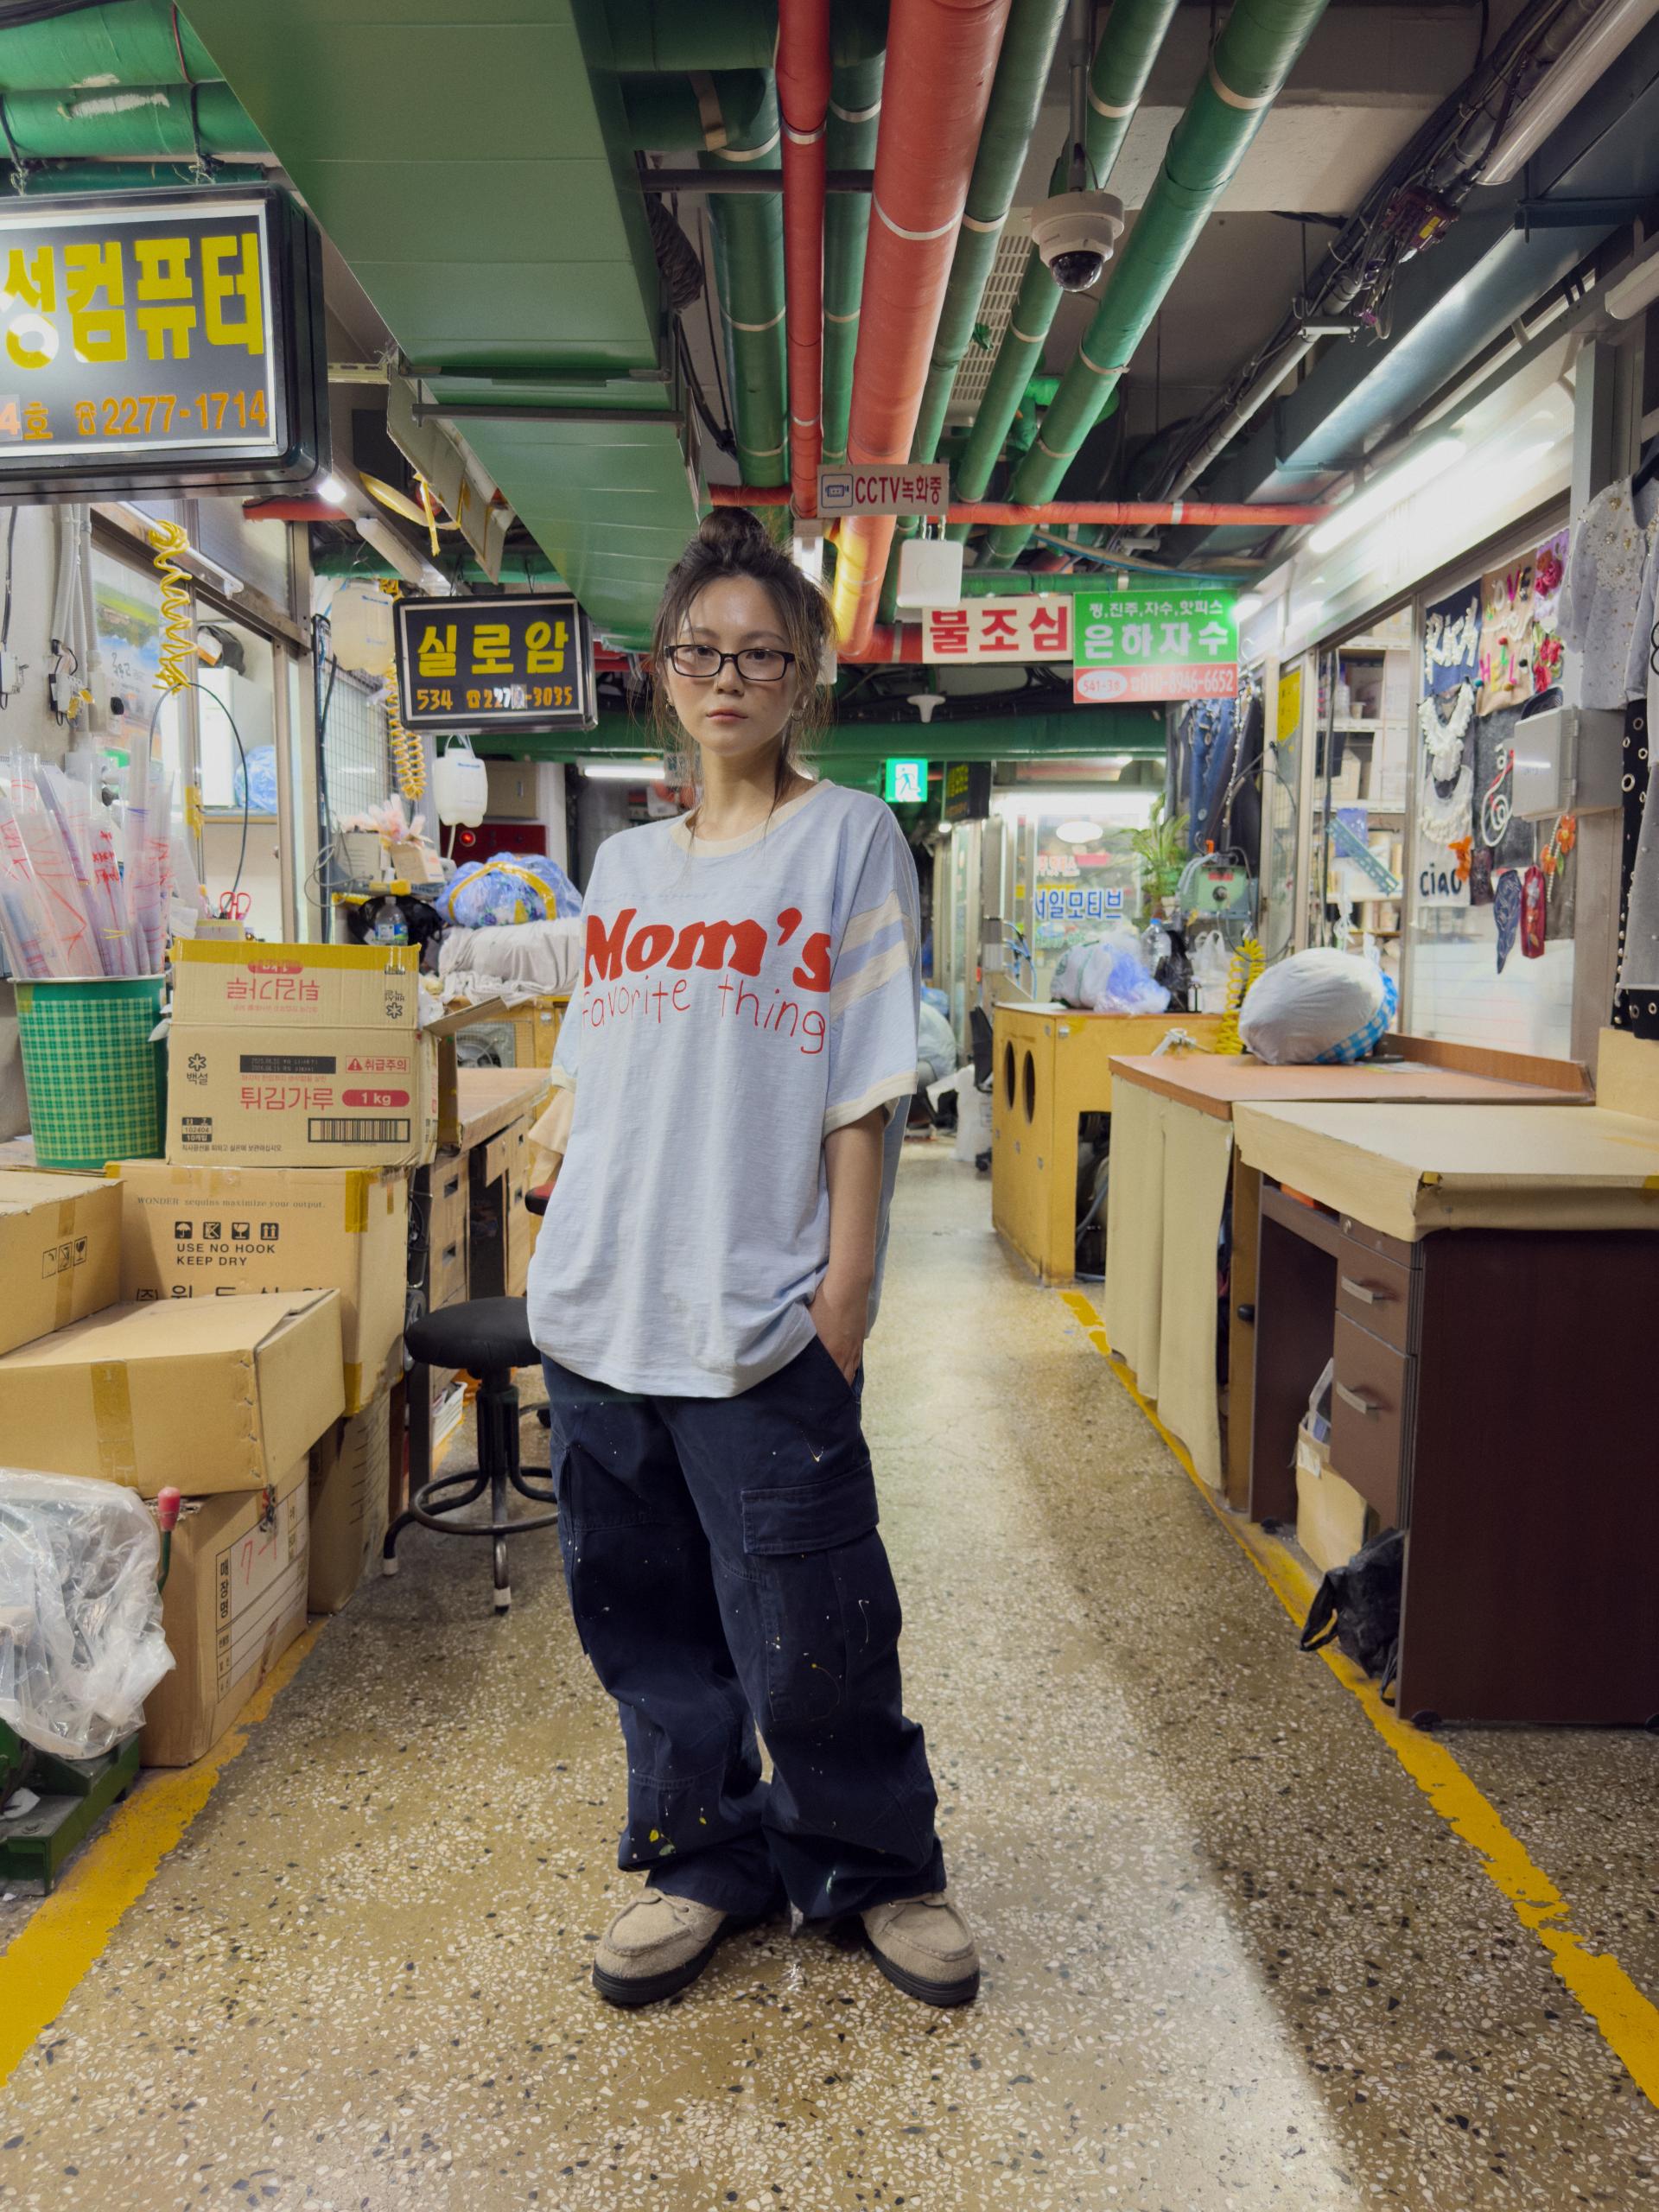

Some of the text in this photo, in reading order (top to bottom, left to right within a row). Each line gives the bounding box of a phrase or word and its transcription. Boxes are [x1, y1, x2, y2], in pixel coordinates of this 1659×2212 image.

[0, 232, 264, 369] 성컴퓨터
[102, 390, 267, 435] 2277-1714
[930, 606, 1068, 654] 불조심
[1084, 621, 1229, 659] 은하자수
[417, 621, 569, 677] 실로암
[416, 690, 454, 711] 534
[584, 907, 830, 992] Mom's
[226, 977, 320, 1001] 튀김가루
[718, 975, 826, 1054] thing
[365, 1058, 407, 1072] 취급주의
[187, 1072, 208, 1085] 백설
[240, 1086, 334, 1110] 튀김가루
[361, 1092, 391, 1107] 1 kg
[137, 1198, 180, 1206] WONDER
[223, 1198, 267, 1208] maximize
[176, 1243, 276, 1254] USE NO HOOK
[176, 1256, 247, 1267] KEEP DRY
